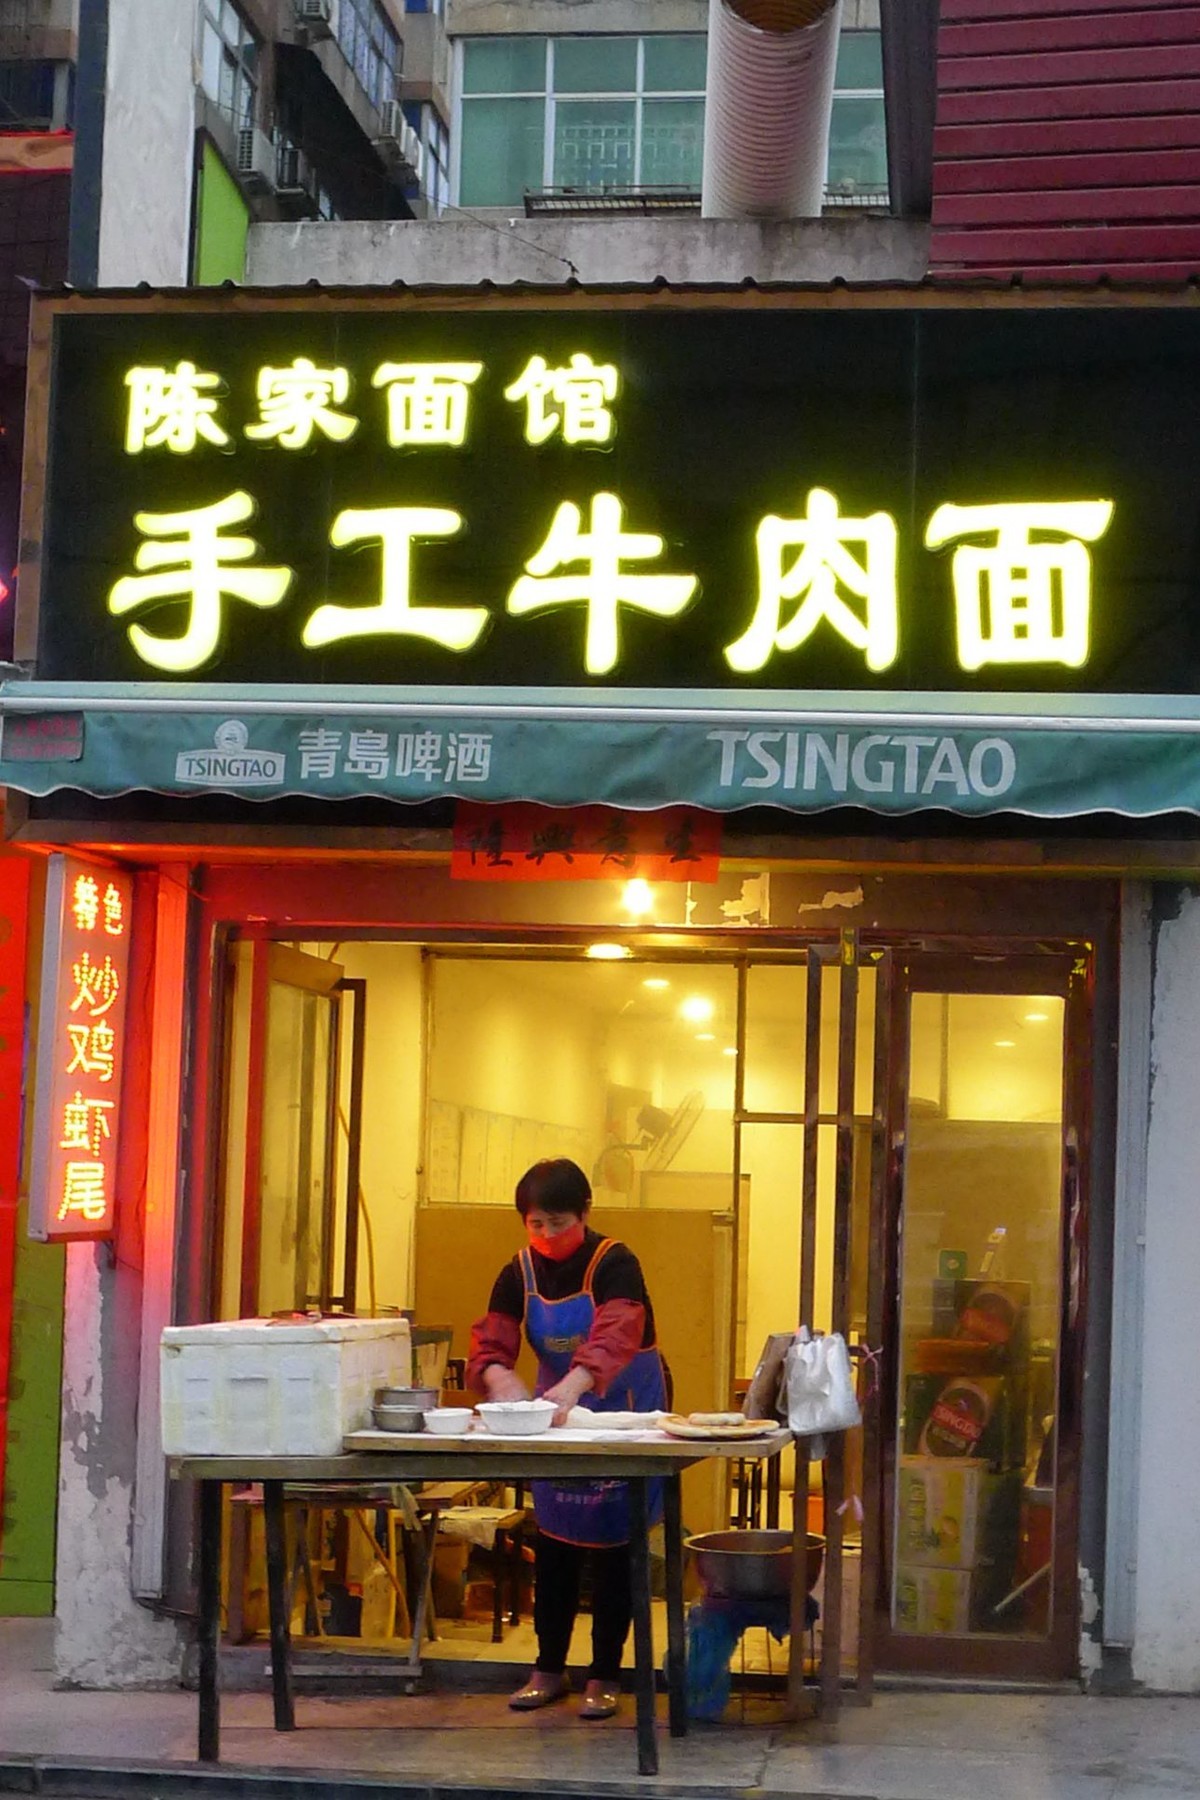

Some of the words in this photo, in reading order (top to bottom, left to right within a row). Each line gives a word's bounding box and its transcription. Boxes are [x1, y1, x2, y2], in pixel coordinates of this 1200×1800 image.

[123, 353, 620, 456] 陈家面馆
[107, 487, 1116, 676] 手工牛肉面
[184, 757, 277, 778] TSINGTAO
[297, 728, 492, 784] 青島啤酒
[706, 729, 1017, 798] TSINGTAO
